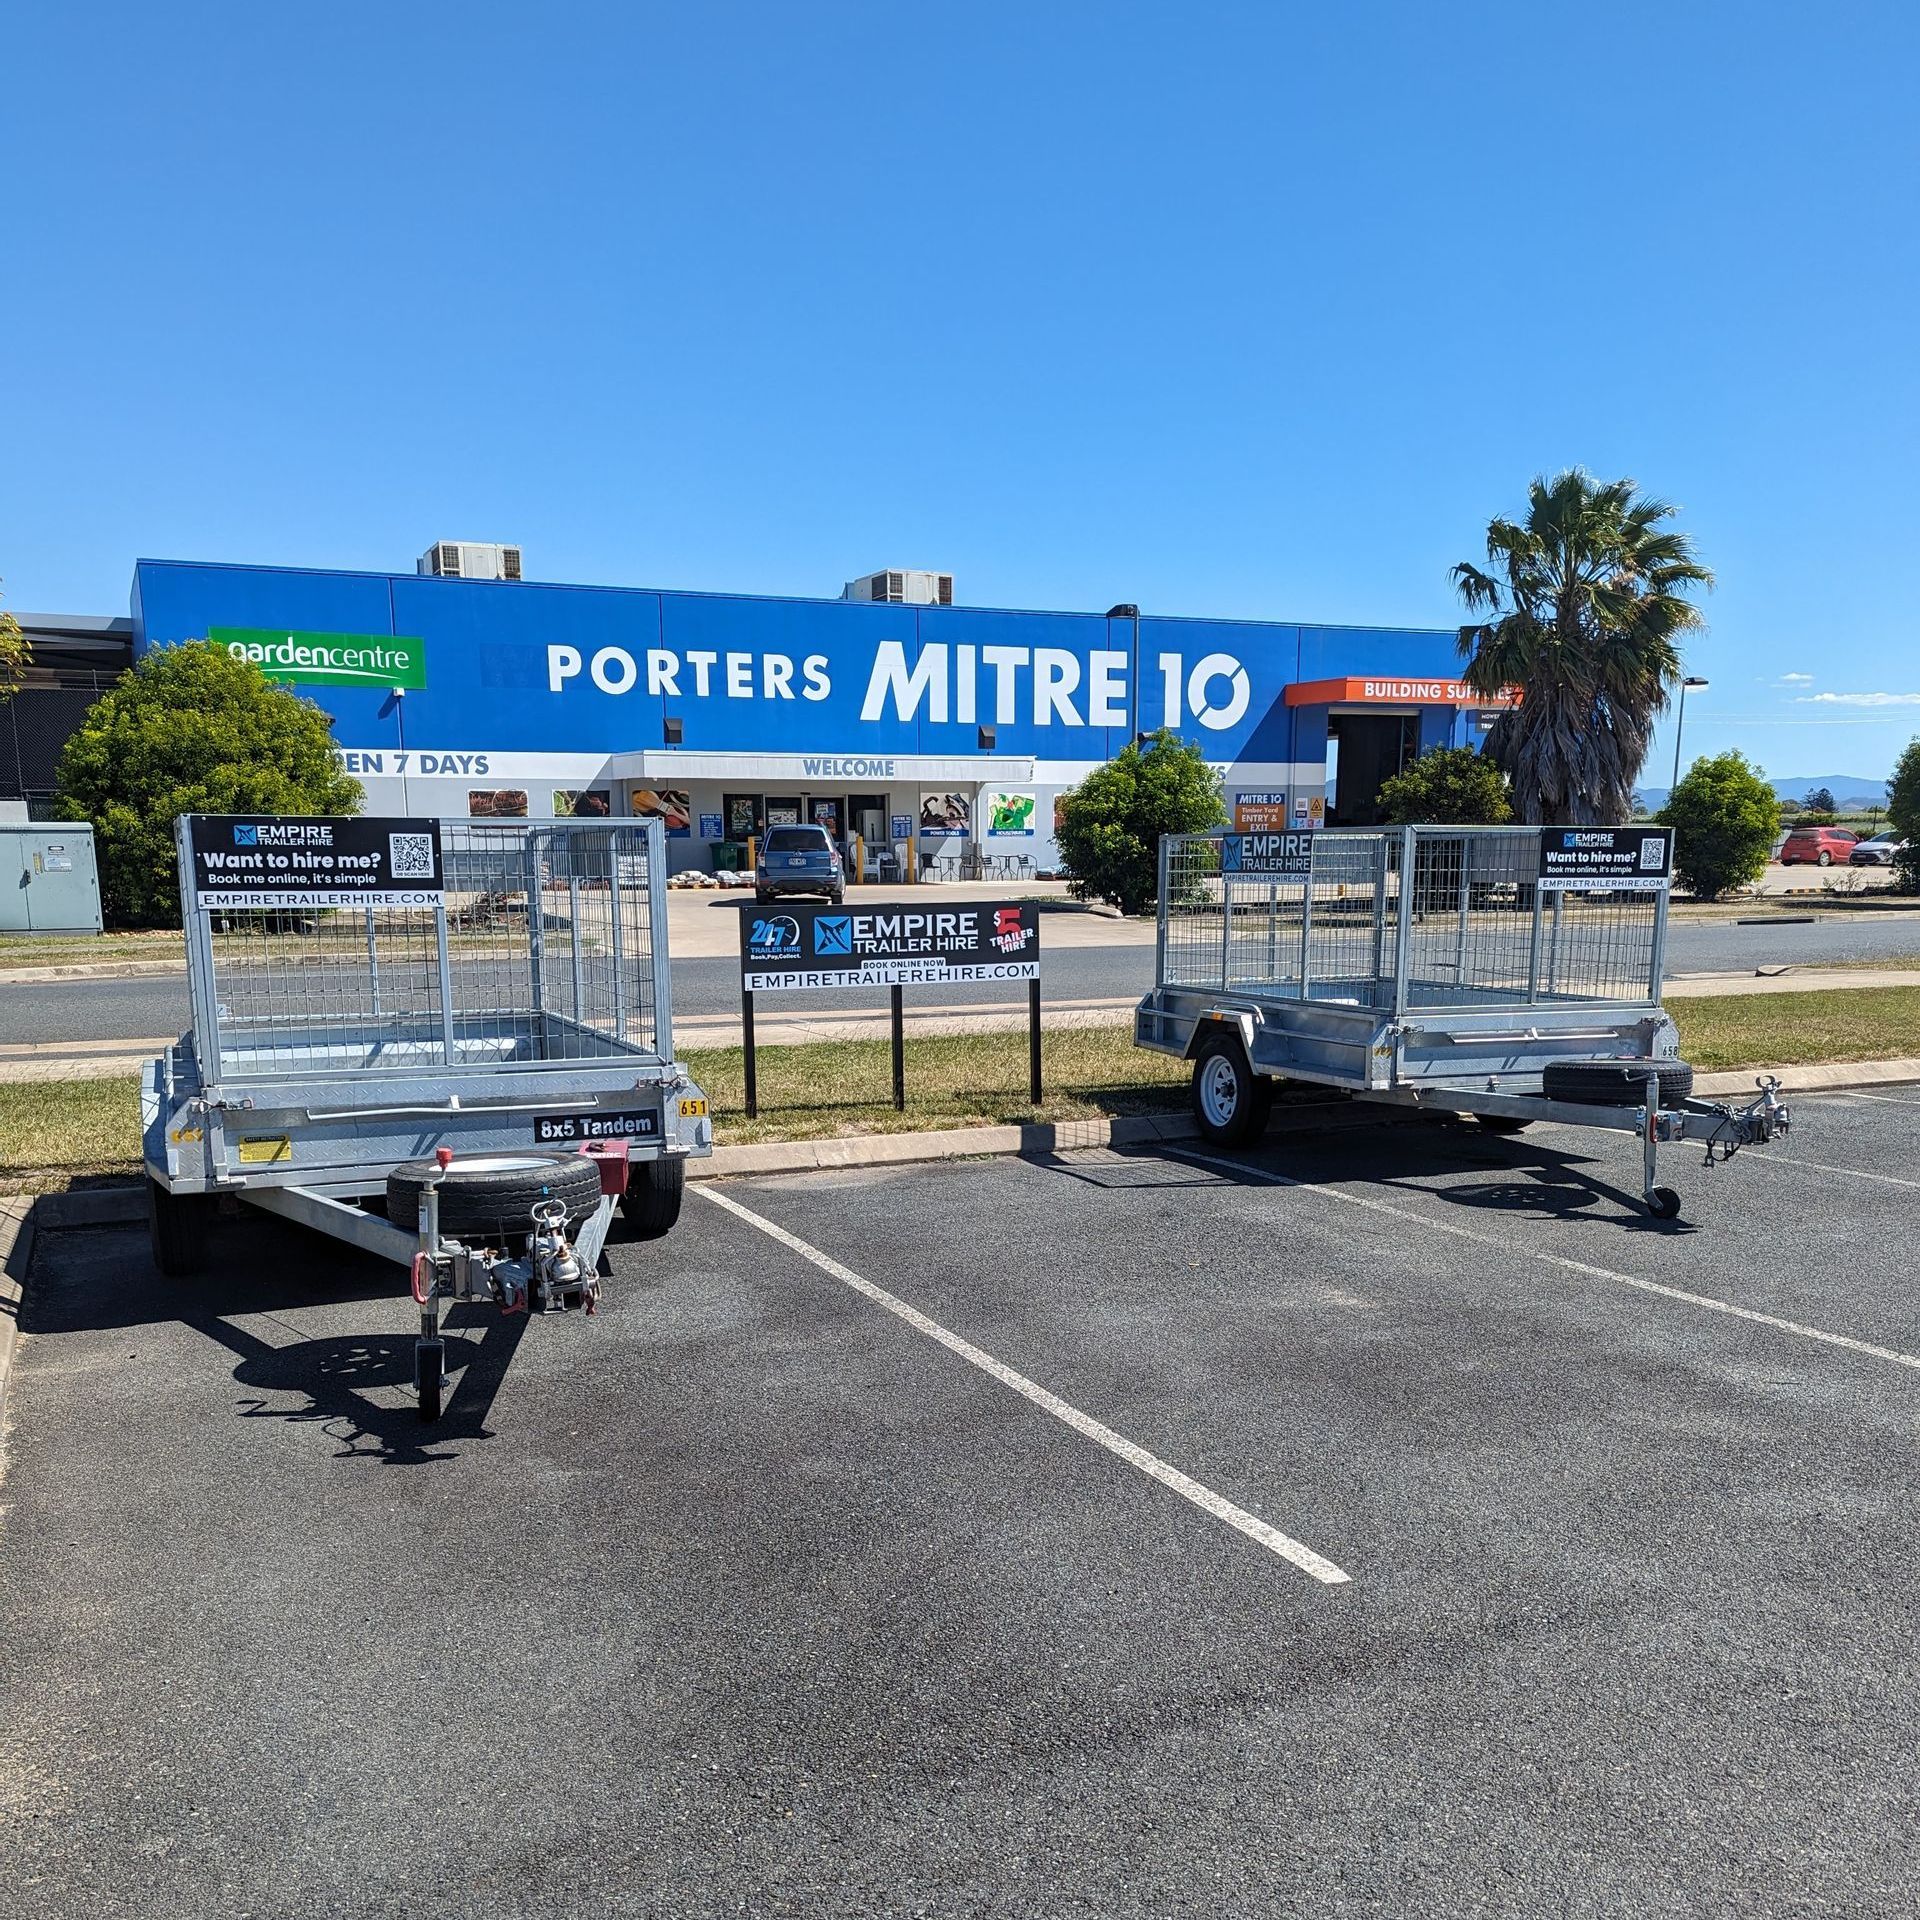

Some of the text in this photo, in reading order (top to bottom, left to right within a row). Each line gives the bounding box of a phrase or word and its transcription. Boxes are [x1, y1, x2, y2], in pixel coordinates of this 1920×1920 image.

[228, 636, 409, 669] gardencentre
[547, 640, 1250, 730] PORTERS MITRE 10
[1364, 682, 1514, 700] BUILDING SUPIES
[334, 752, 490, 775] PEN 7 DAYS
[802, 759, 895, 776] WELCOME
[1240, 794, 1282, 804] MITRE 10
[1241, 814, 1278, 823] ENTRY &
[256, 825, 333, 839] EMPIRE
[1250, 823, 1269, 832] EXIT
[256, 838, 334, 847] TRAILER HIRE
[1575, 833, 1615, 842] EMPIRE
[1241, 834, 1311, 857] EMPIRE
[203, 852, 382, 868] Want to hire me?
[1546, 850, 1637, 863] Want to hire me?
[1241, 857, 1311, 871] TRAILER HIRE
[1576, 866, 1599, 874] online,
[1610, 866, 1633, 876] simple
[208, 873, 377, 887] Book me online, it's simple
[1542, 879, 1664, 888] EMPIRETRAILERHIRE.COM
[203, 893, 440, 905] EMPIRETRAILERHIRE.COM
[852, 911, 979, 940] EMPIRE
[993, 908, 1021, 934] $5
[852, 936, 979, 954] TRAILER HIRE
[989, 928, 1034, 948] TRAILER
[751, 945, 802, 954] TRAILER HIRE
[1000, 939, 1027, 954] HIRE
[863, 959, 945, 970] BOOK ONLINE NOW
[751, 964, 1035, 989] EMPIRETRAILEREHIRE.COM
[1662, 1045, 1678, 1057] 658
[681, 1100, 706, 1115] 651
[540, 1115, 651, 1139] 8x5 Tandem
